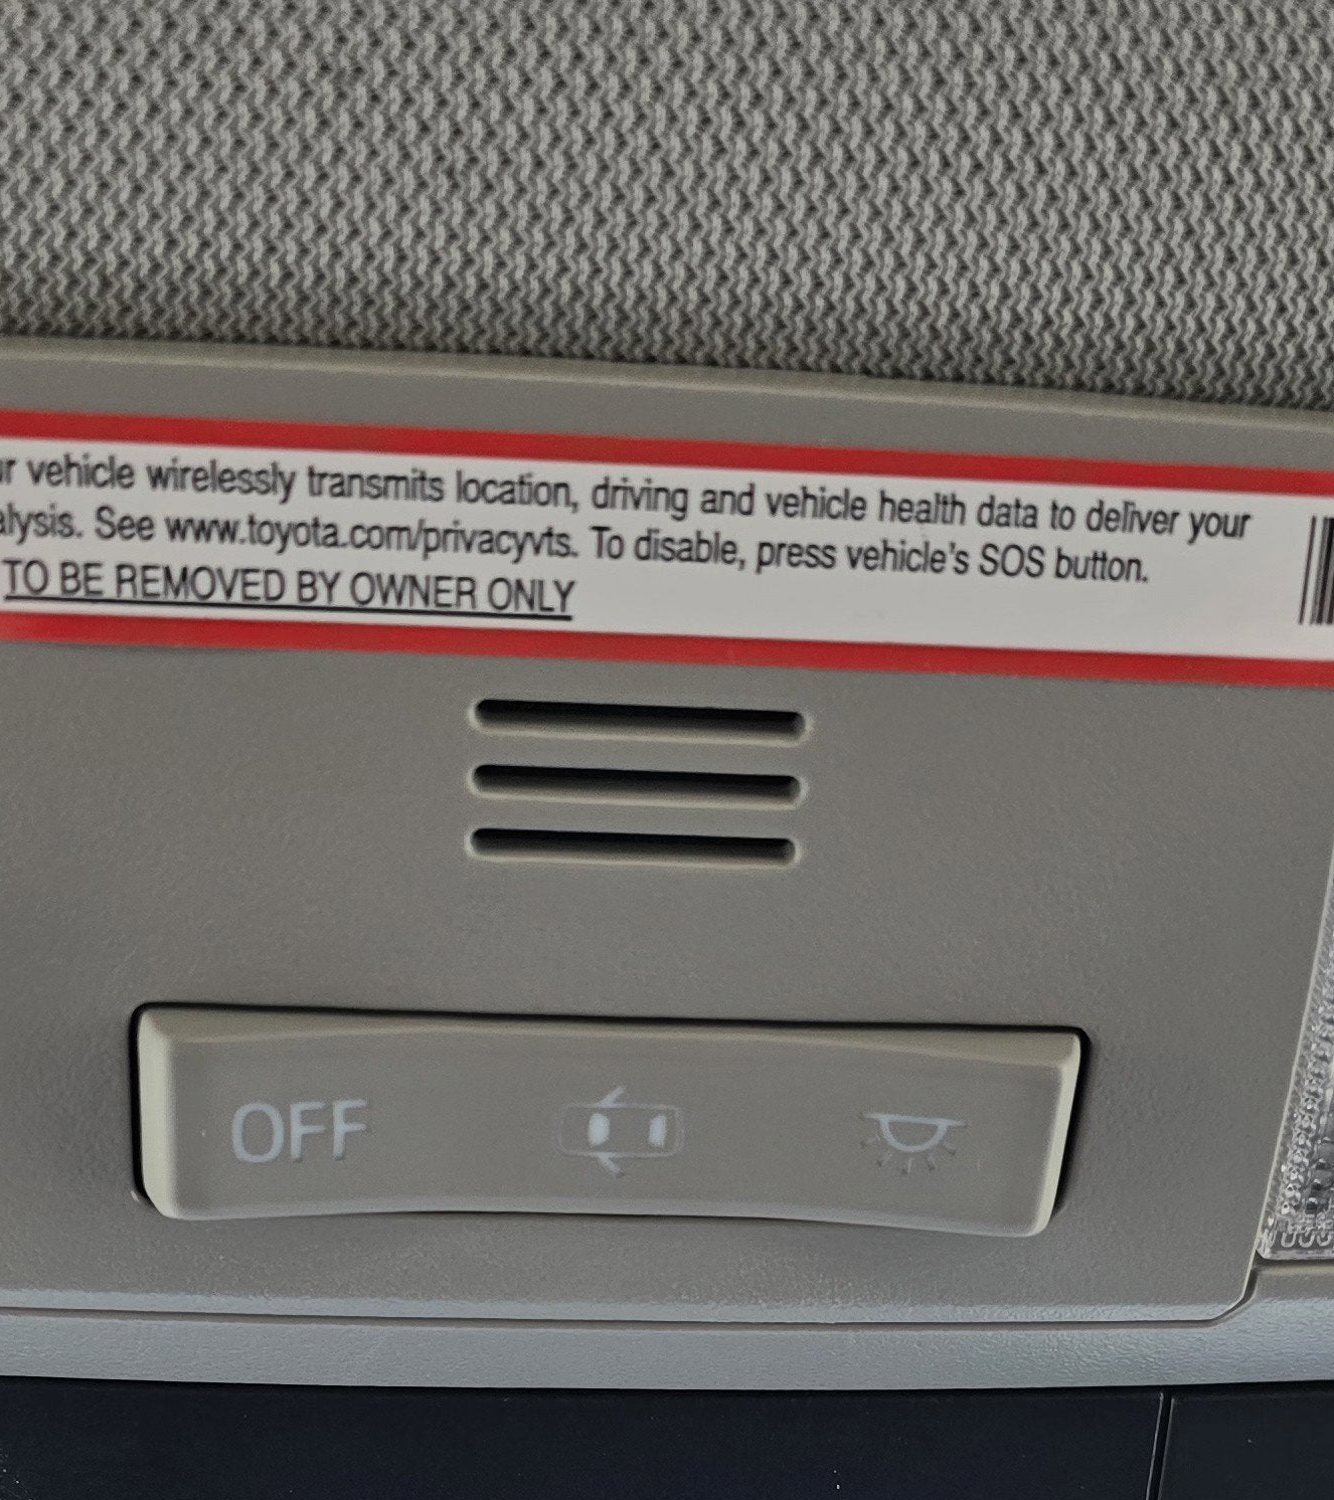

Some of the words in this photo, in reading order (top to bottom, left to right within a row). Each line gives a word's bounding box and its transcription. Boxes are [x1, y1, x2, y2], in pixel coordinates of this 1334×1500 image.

[27, 453, 135, 489] vehicle
[147, 457, 296, 504] wirelessly
[307, 466, 444, 502] transmits
[455, 469, 579, 513] location,
[591, 477, 688, 520] driving
[701, 483, 755, 516] and
[765, 484, 867, 521] vehicle
[878, 490, 966, 526] health
[977, 495, 1038, 529] data
[1050, 501, 1076, 531] to
[1086, 501, 1180, 535] deliver
[1188, 511, 1251, 546] your
[96, 507, 155, 540] See
[166, 512, 579, 565] www.toyota.com/privacyvts.
[590, 527, 625, 559] To
[634, 527, 746, 569] disable,
[756, 541, 837, 574] press
[847, 540, 969, 574] vehicle's
[979, 543, 1045, 578] SOS
[1055, 548, 1149, 584] button.
[2, 559, 49, 596] TO
[60, 561, 104, 598] BE
[116, 563, 285, 601] REMOVED
[297, 571, 342, 603] BY
[350, 572, 477, 610] OWNER
[488, 578, 576, 613] ONLY
[231, 1099, 372, 1162] OFF
